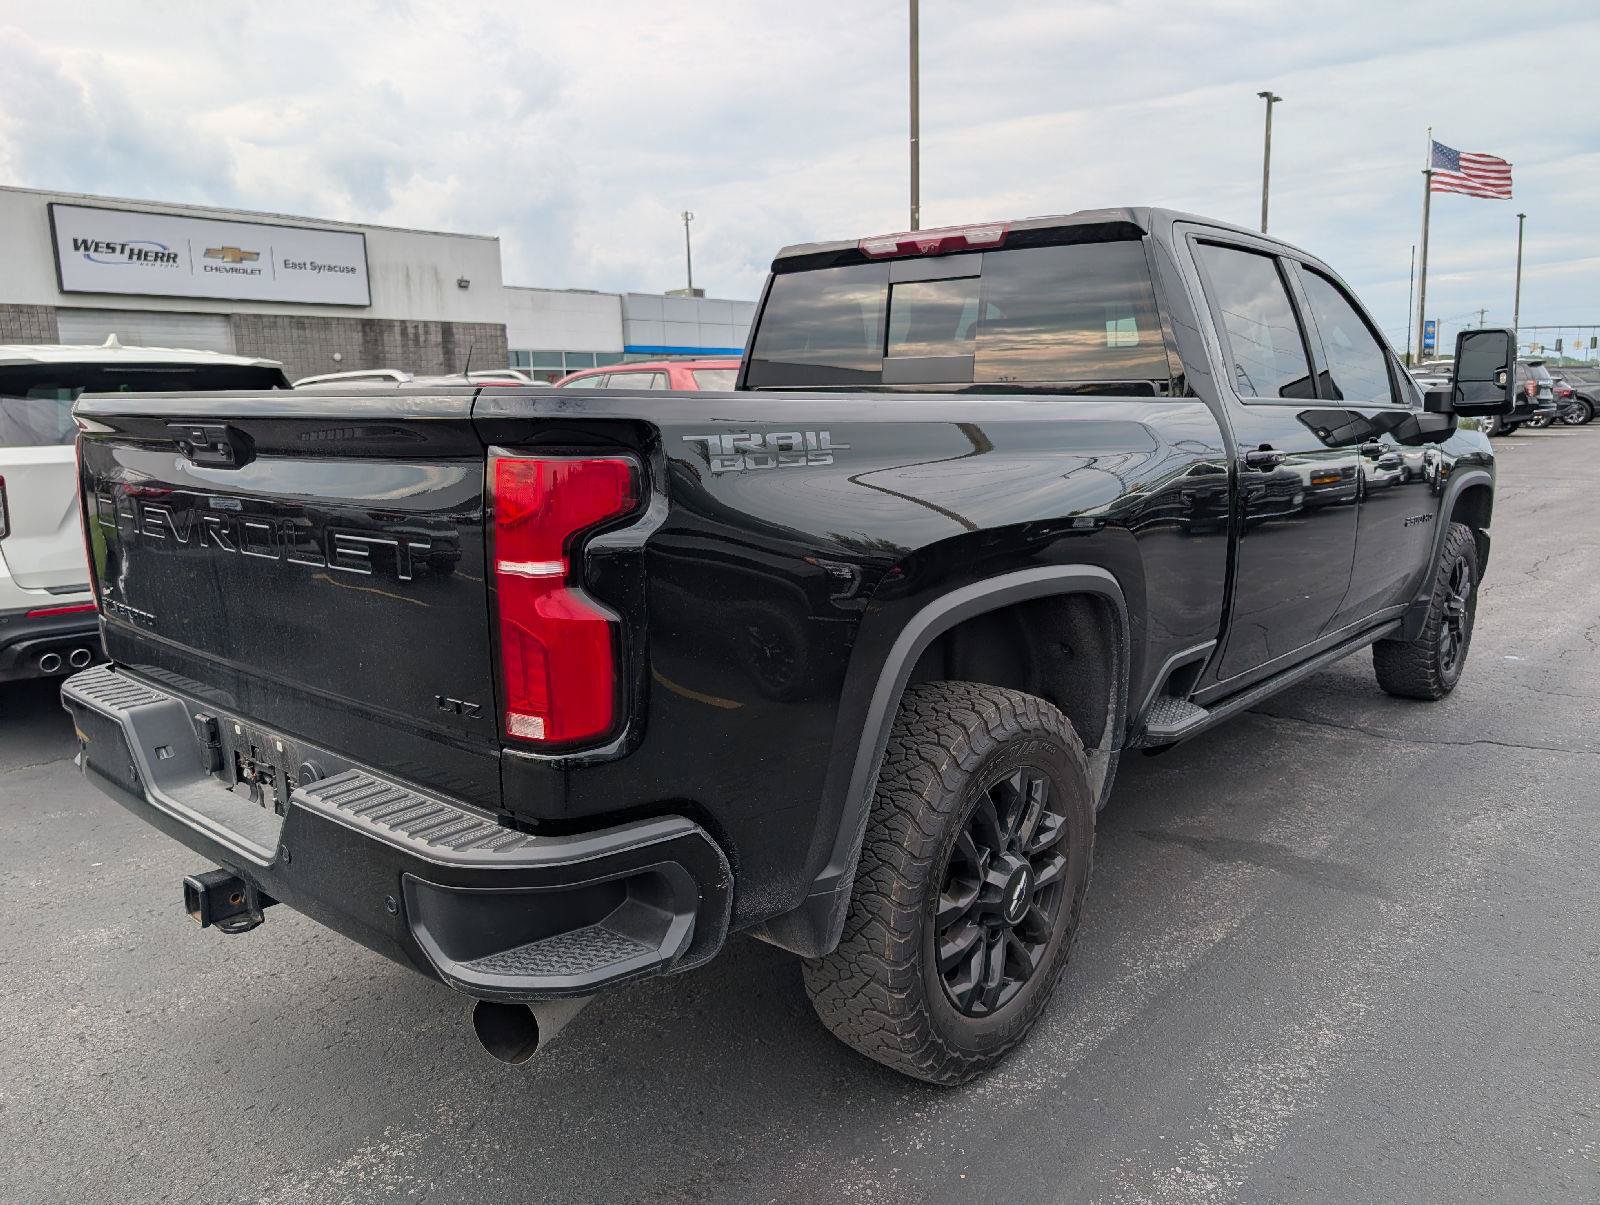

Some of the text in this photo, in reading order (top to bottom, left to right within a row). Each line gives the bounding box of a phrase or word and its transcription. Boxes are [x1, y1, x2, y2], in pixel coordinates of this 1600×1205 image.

[73, 237, 178, 263] WEST HERR
[203, 265, 262, 276] CHEVROLET
[283, 259, 357, 275] East Syracuse
[682, 431, 851, 454] TRAIL
[709, 450, 835, 472] BOSS
[96, 490, 432, 581] CHEVROLET
